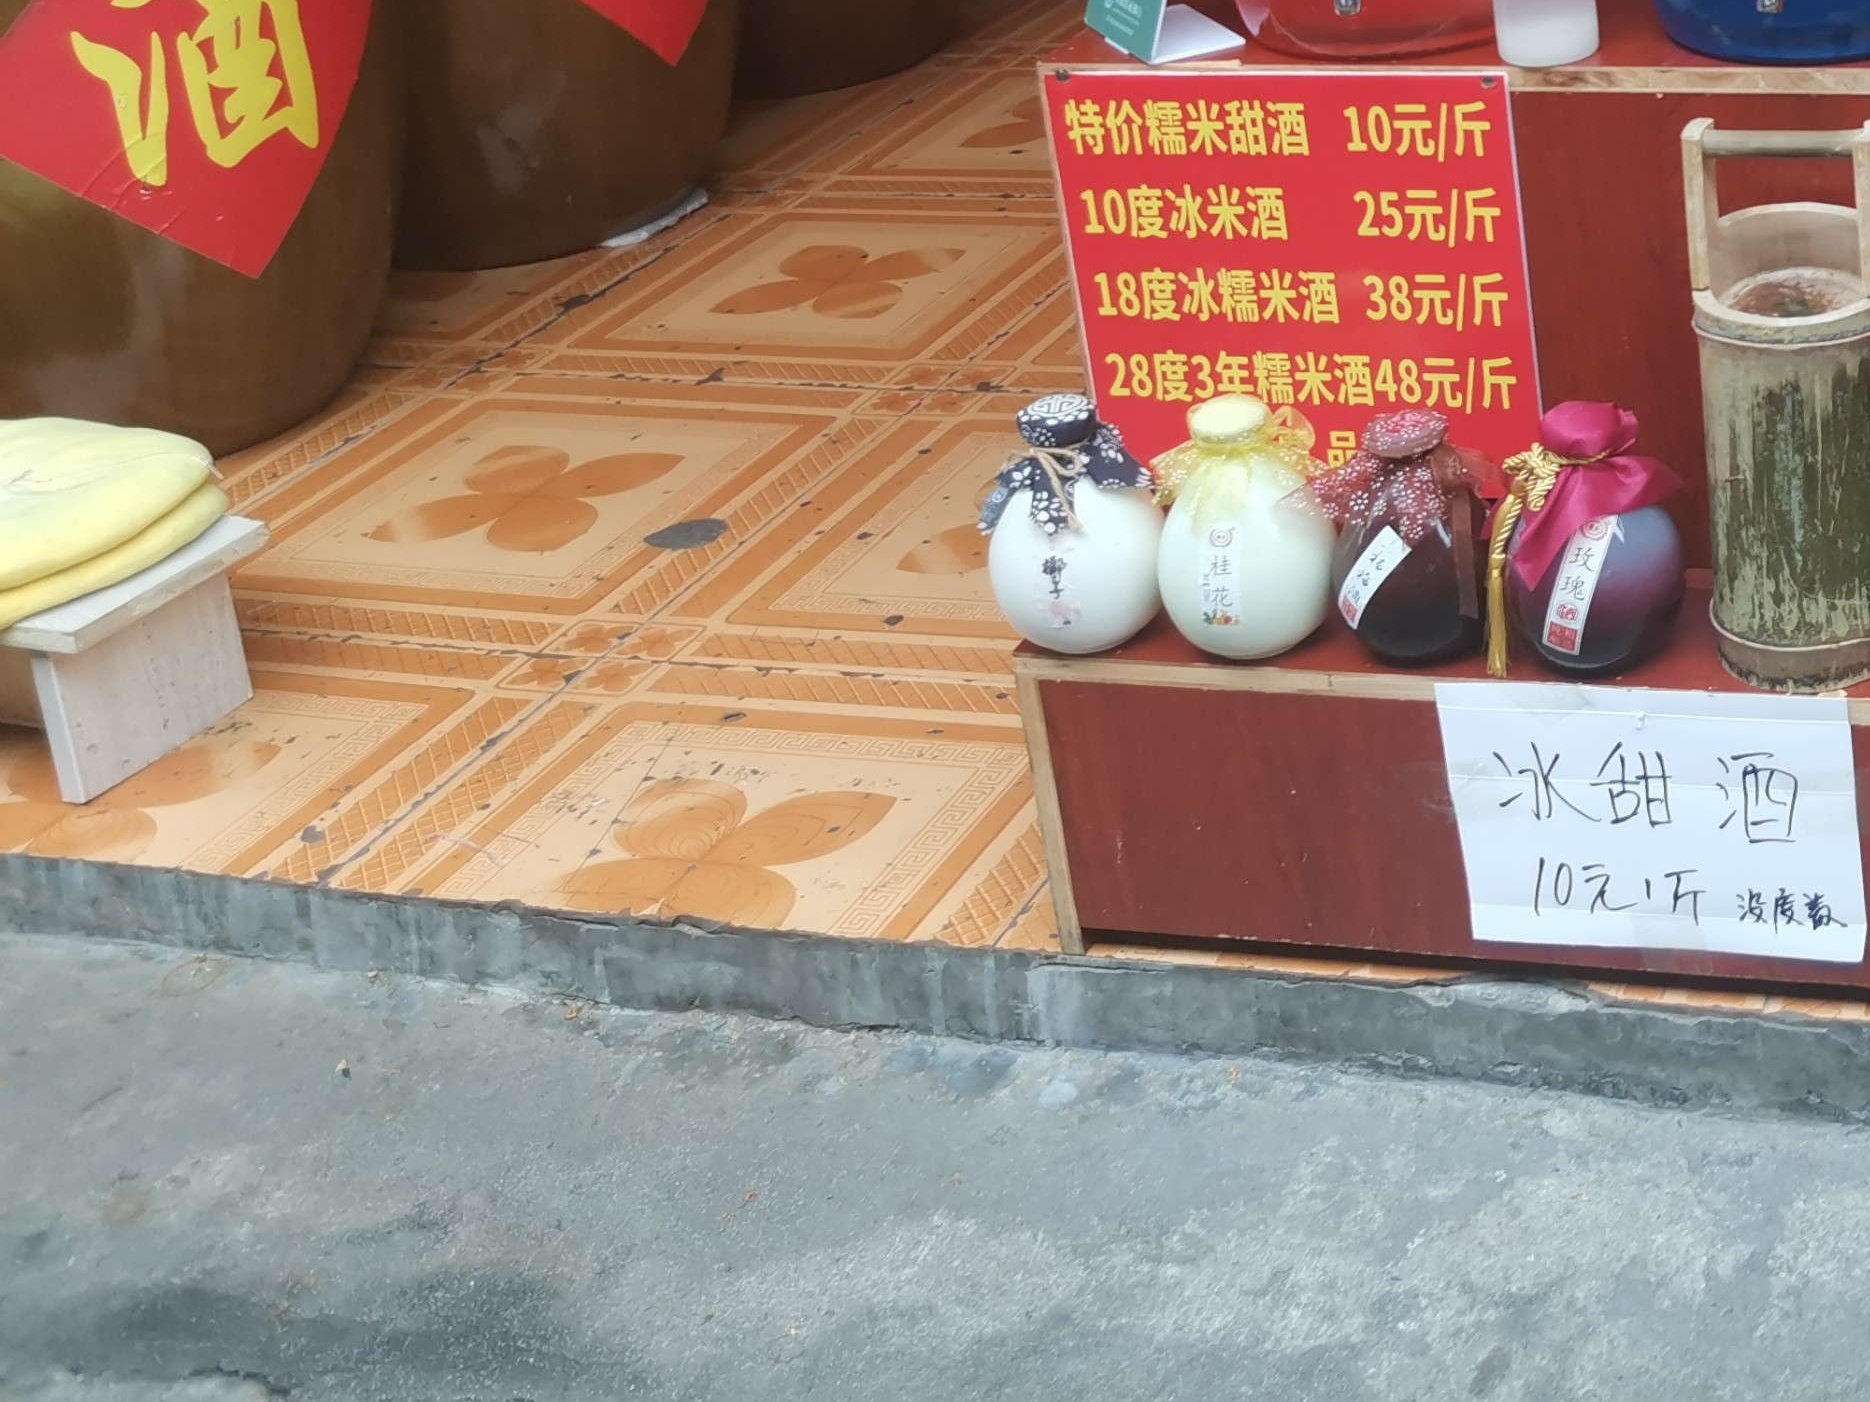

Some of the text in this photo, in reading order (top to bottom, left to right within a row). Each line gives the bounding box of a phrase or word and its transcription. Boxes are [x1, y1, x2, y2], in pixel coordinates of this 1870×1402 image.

[1064, 99, 1491, 162] 特价糯米甜酒 10元/斤
[1080, 184, 1501, 248] 10度冰米酒 25元/斤
[1093, 267, 1509, 333] 18度冰糯米酒 38元/斤
[1042, 555, 1067, 599] 椰子
[1211, 555, 1233, 608] 桂花
[1560, 547, 1594, 601] 玫瑰
[1493, 741, 1798, 844] 冰甜酒
